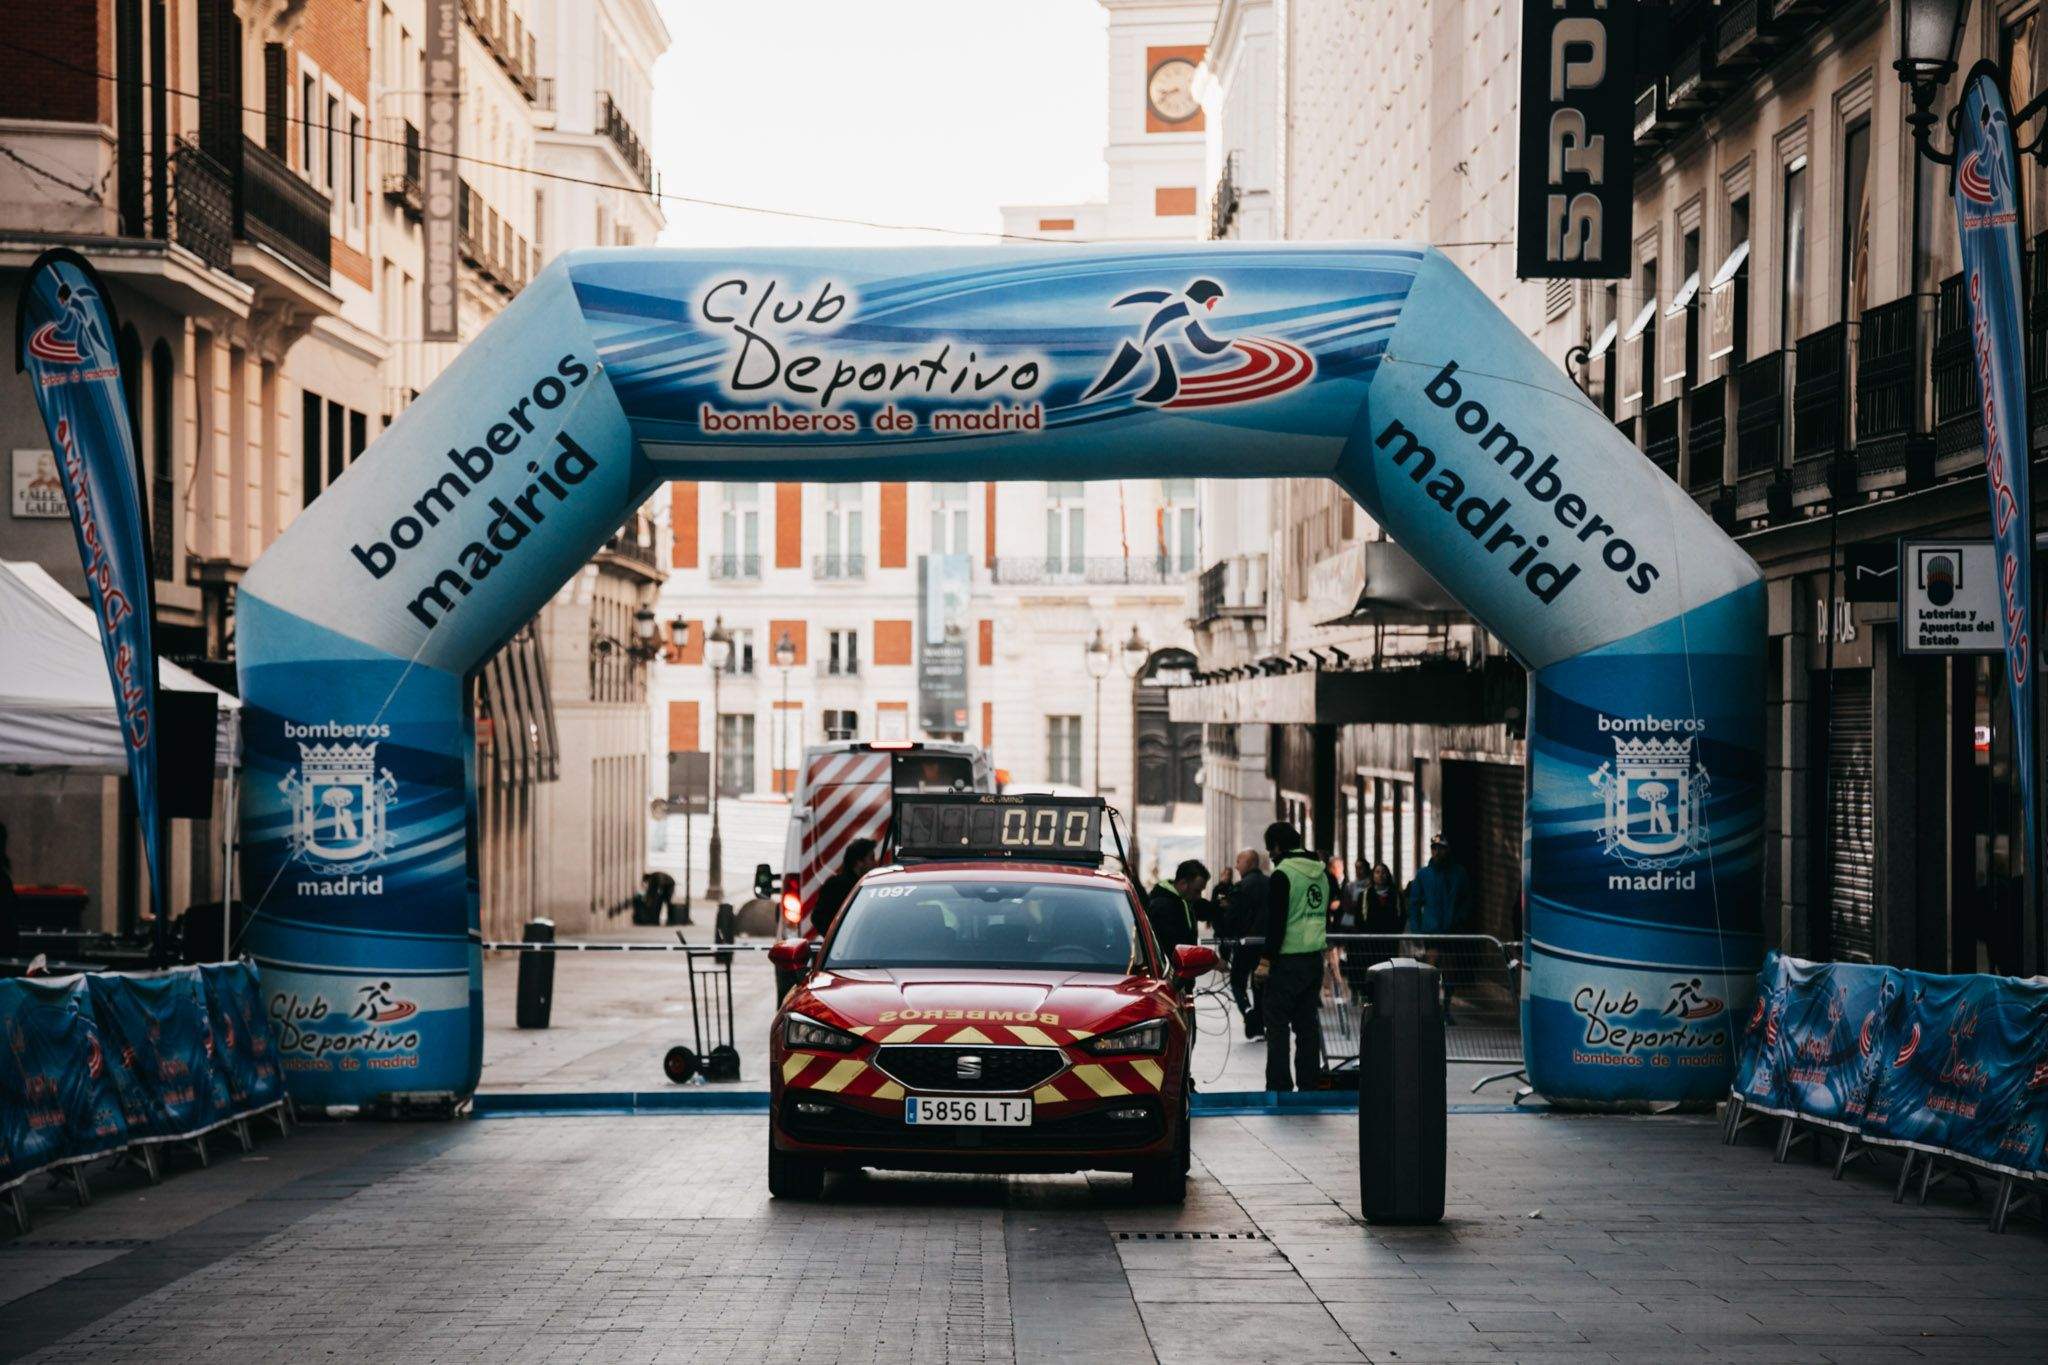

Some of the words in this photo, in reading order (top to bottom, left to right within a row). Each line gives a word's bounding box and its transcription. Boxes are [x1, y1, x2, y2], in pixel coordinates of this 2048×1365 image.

[702, 279, 845, 327] Club
[731, 325, 1039, 407] Deportivo
[703, 406, 856, 430] bomberos
[876, 406, 914, 430] de
[934, 405, 1041, 430] madrid
[351, 354, 589, 580] bomberos
[1424, 360, 1660, 594] bomberos
[1375, 418, 1582, 606] madrid
[406, 430, 599, 630] madrid
[1969, 610, 1977, 621] y
[1919, 622, 1974, 635] Apuestas
[1976, 620, 1995, 632] del
[1919, 634, 1960, 646] Estado
[285, 720, 391, 738] bomberos
[1598, 713, 1706, 732] bomberos
[297, 875, 384, 896] madrid
[868, 885, 918, 898] 1097
[1608, 870, 1696, 891] madrid
[269, 993, 328, 1021] Club
[1574, 987, 1639, 1015] Club
[280, 1018, 418, 1058] Deportivo
[1586, 1013, 1726, 1053] Deportivo
[340, 1057, 359, 1070] de
[368, 1055, 417, 1069] madrid
[1573, 1050, 1643, 1066] bomberos
[1651, 1053, 1670, 1067] de
[921, 1101, 977, 1121] 5856
[984, 1102, 1026, 1122] LTJ
